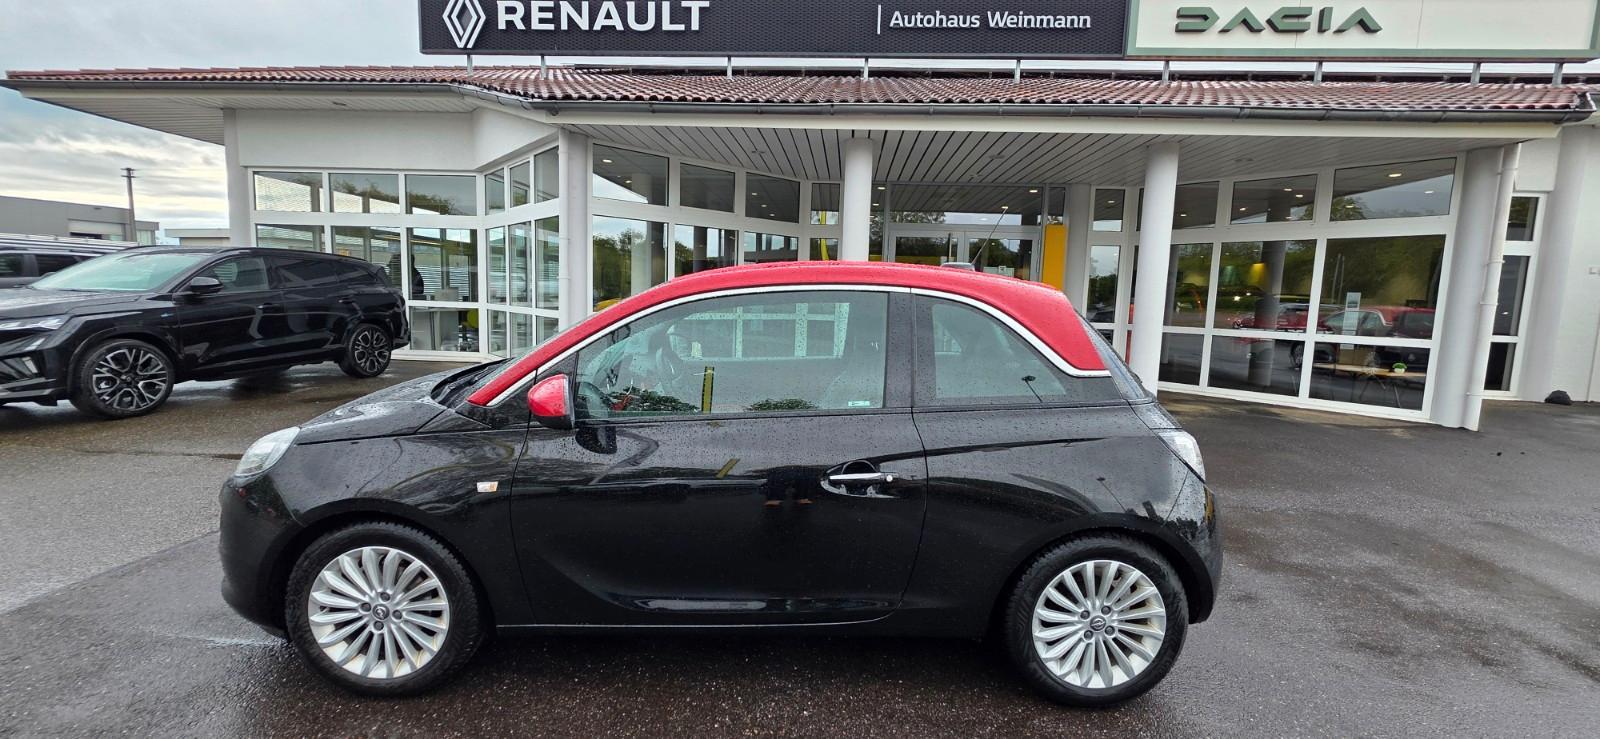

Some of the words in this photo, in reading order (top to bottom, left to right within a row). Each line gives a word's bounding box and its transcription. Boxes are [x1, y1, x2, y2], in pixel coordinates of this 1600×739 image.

[497, 0, 709, 31] RENAULT
[889, 11, 980, 28] Autohaus
[987, 11, 1091, 29] Weinmann
[1175, 6, 1383, 33] DACIA
